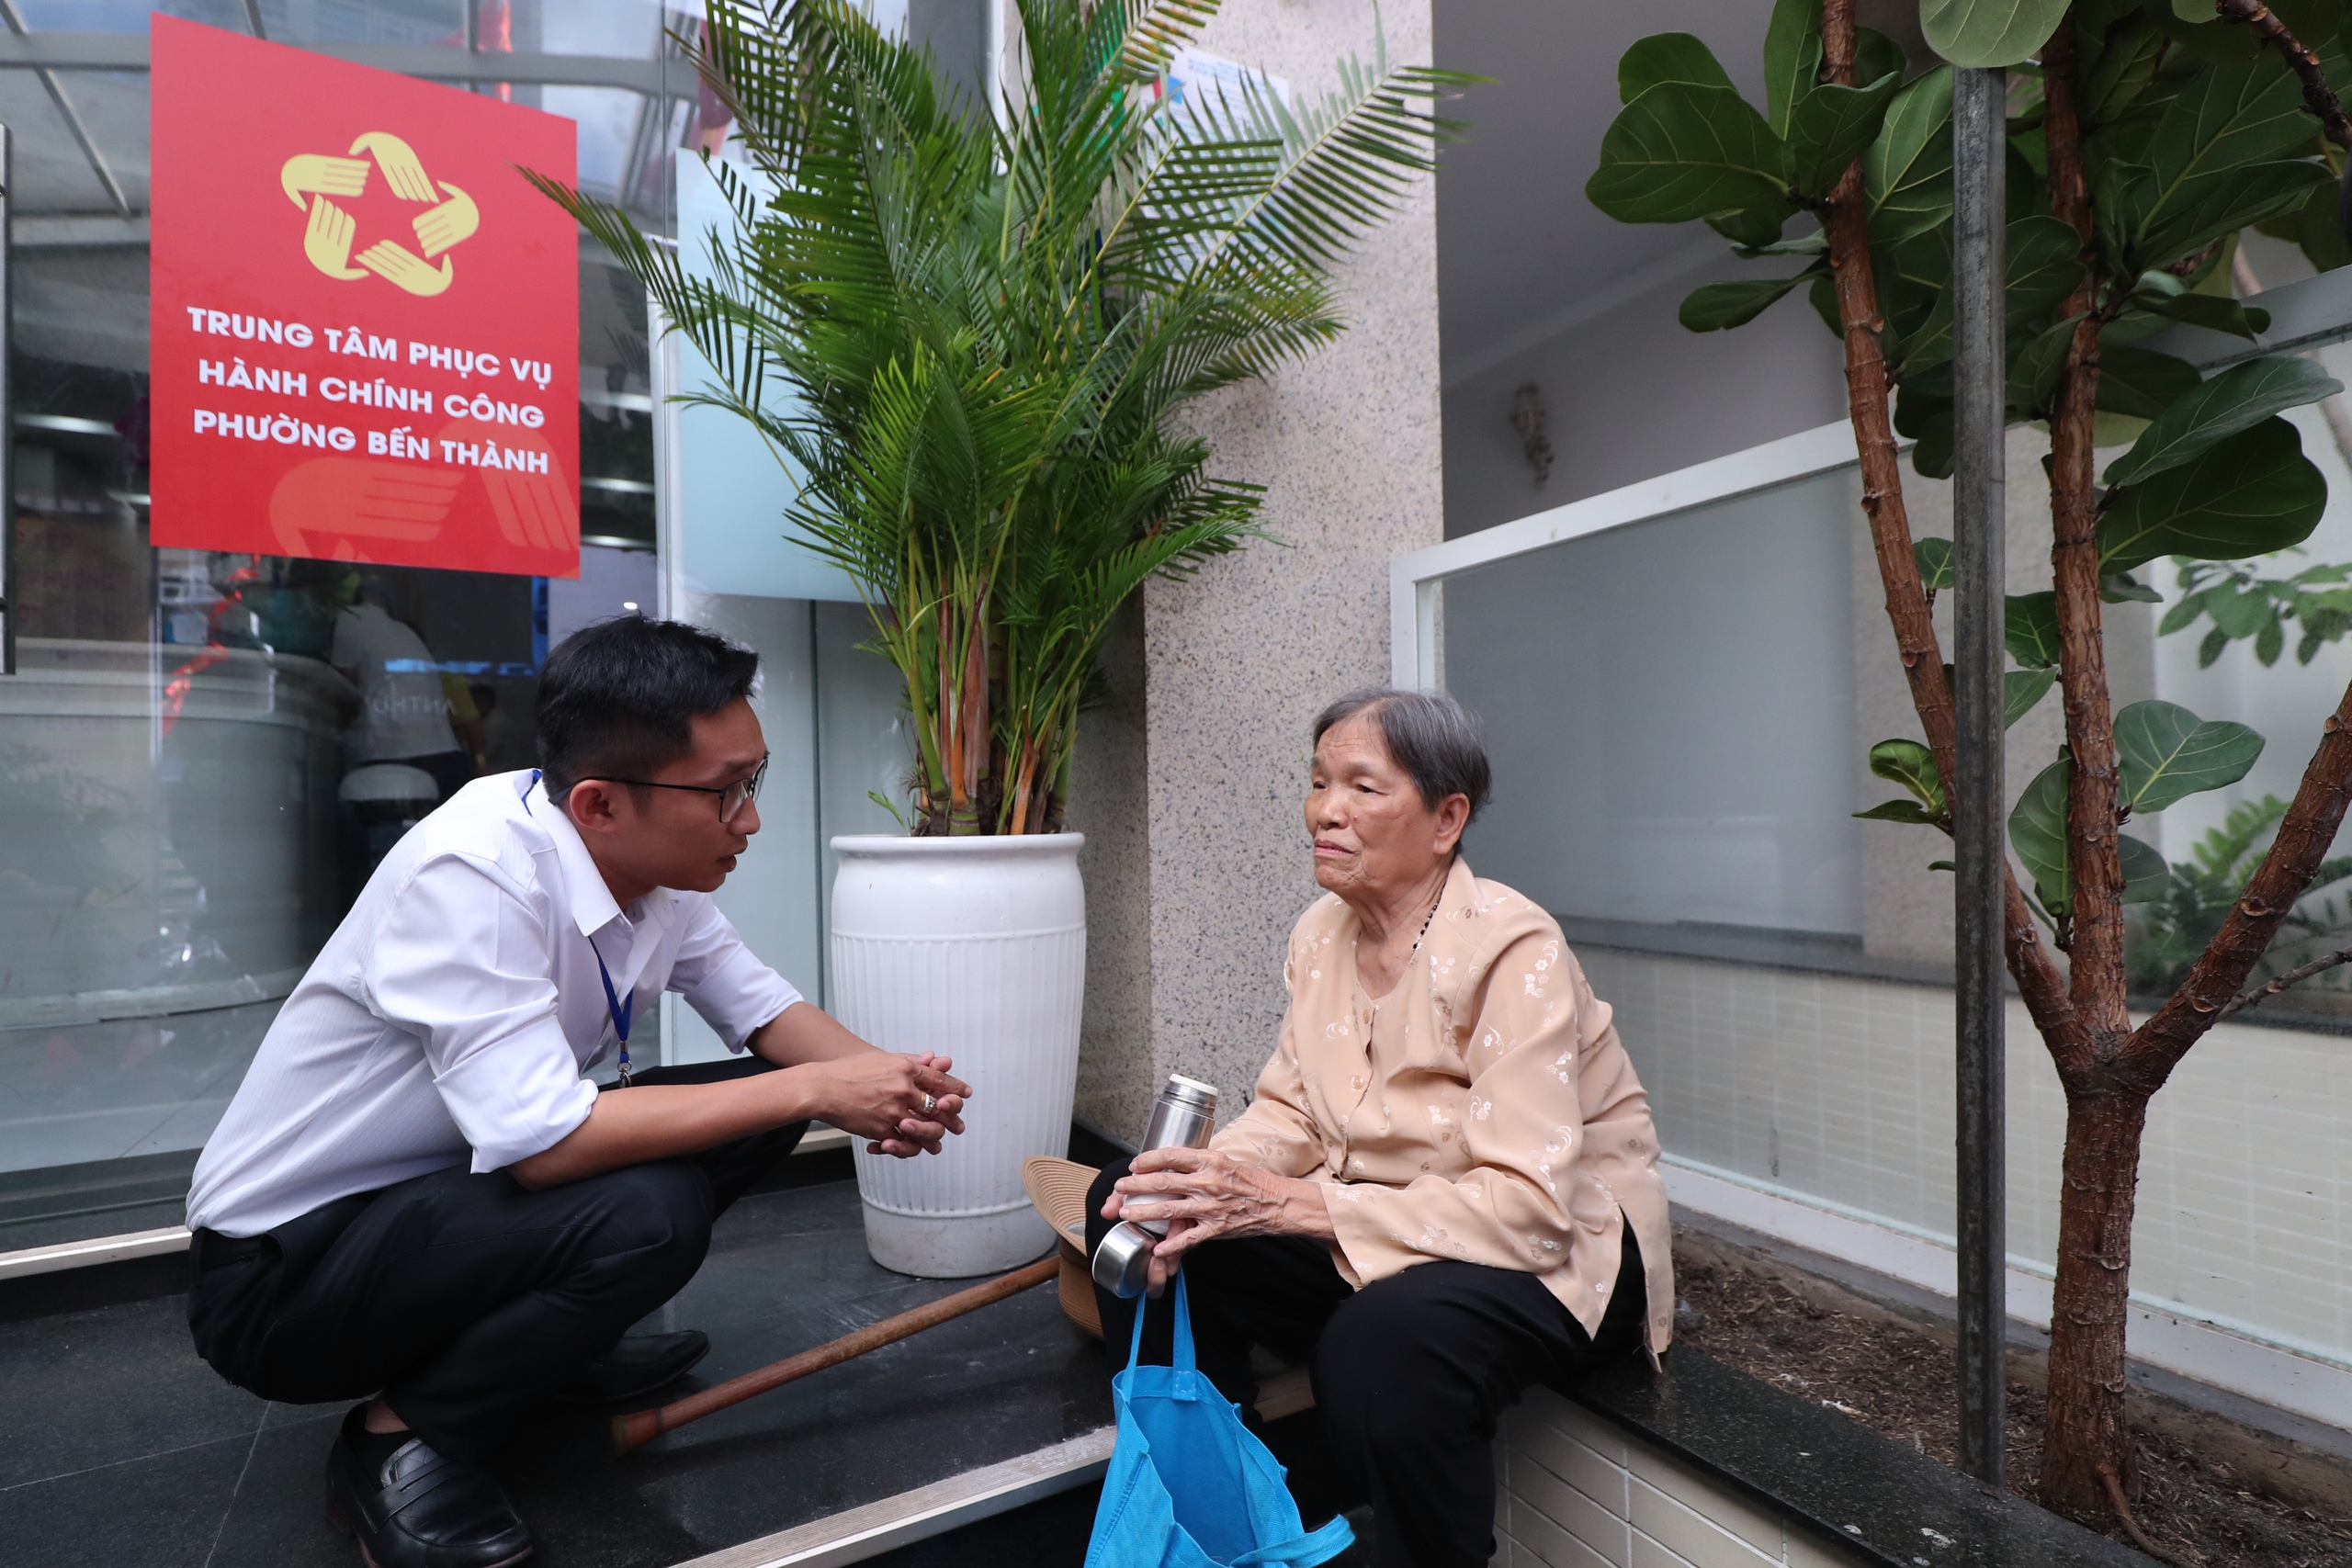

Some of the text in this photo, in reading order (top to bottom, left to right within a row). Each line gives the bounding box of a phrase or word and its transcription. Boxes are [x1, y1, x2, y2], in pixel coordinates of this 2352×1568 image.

[187, 306, 552, 390] TRUNG TÂM PHỤC VỤ
[198, 356, 545, 429] HÀNH CHÍNH CÔNG
[194, 409, 548, 475] PHƯỜNG BẾN THÀNH
